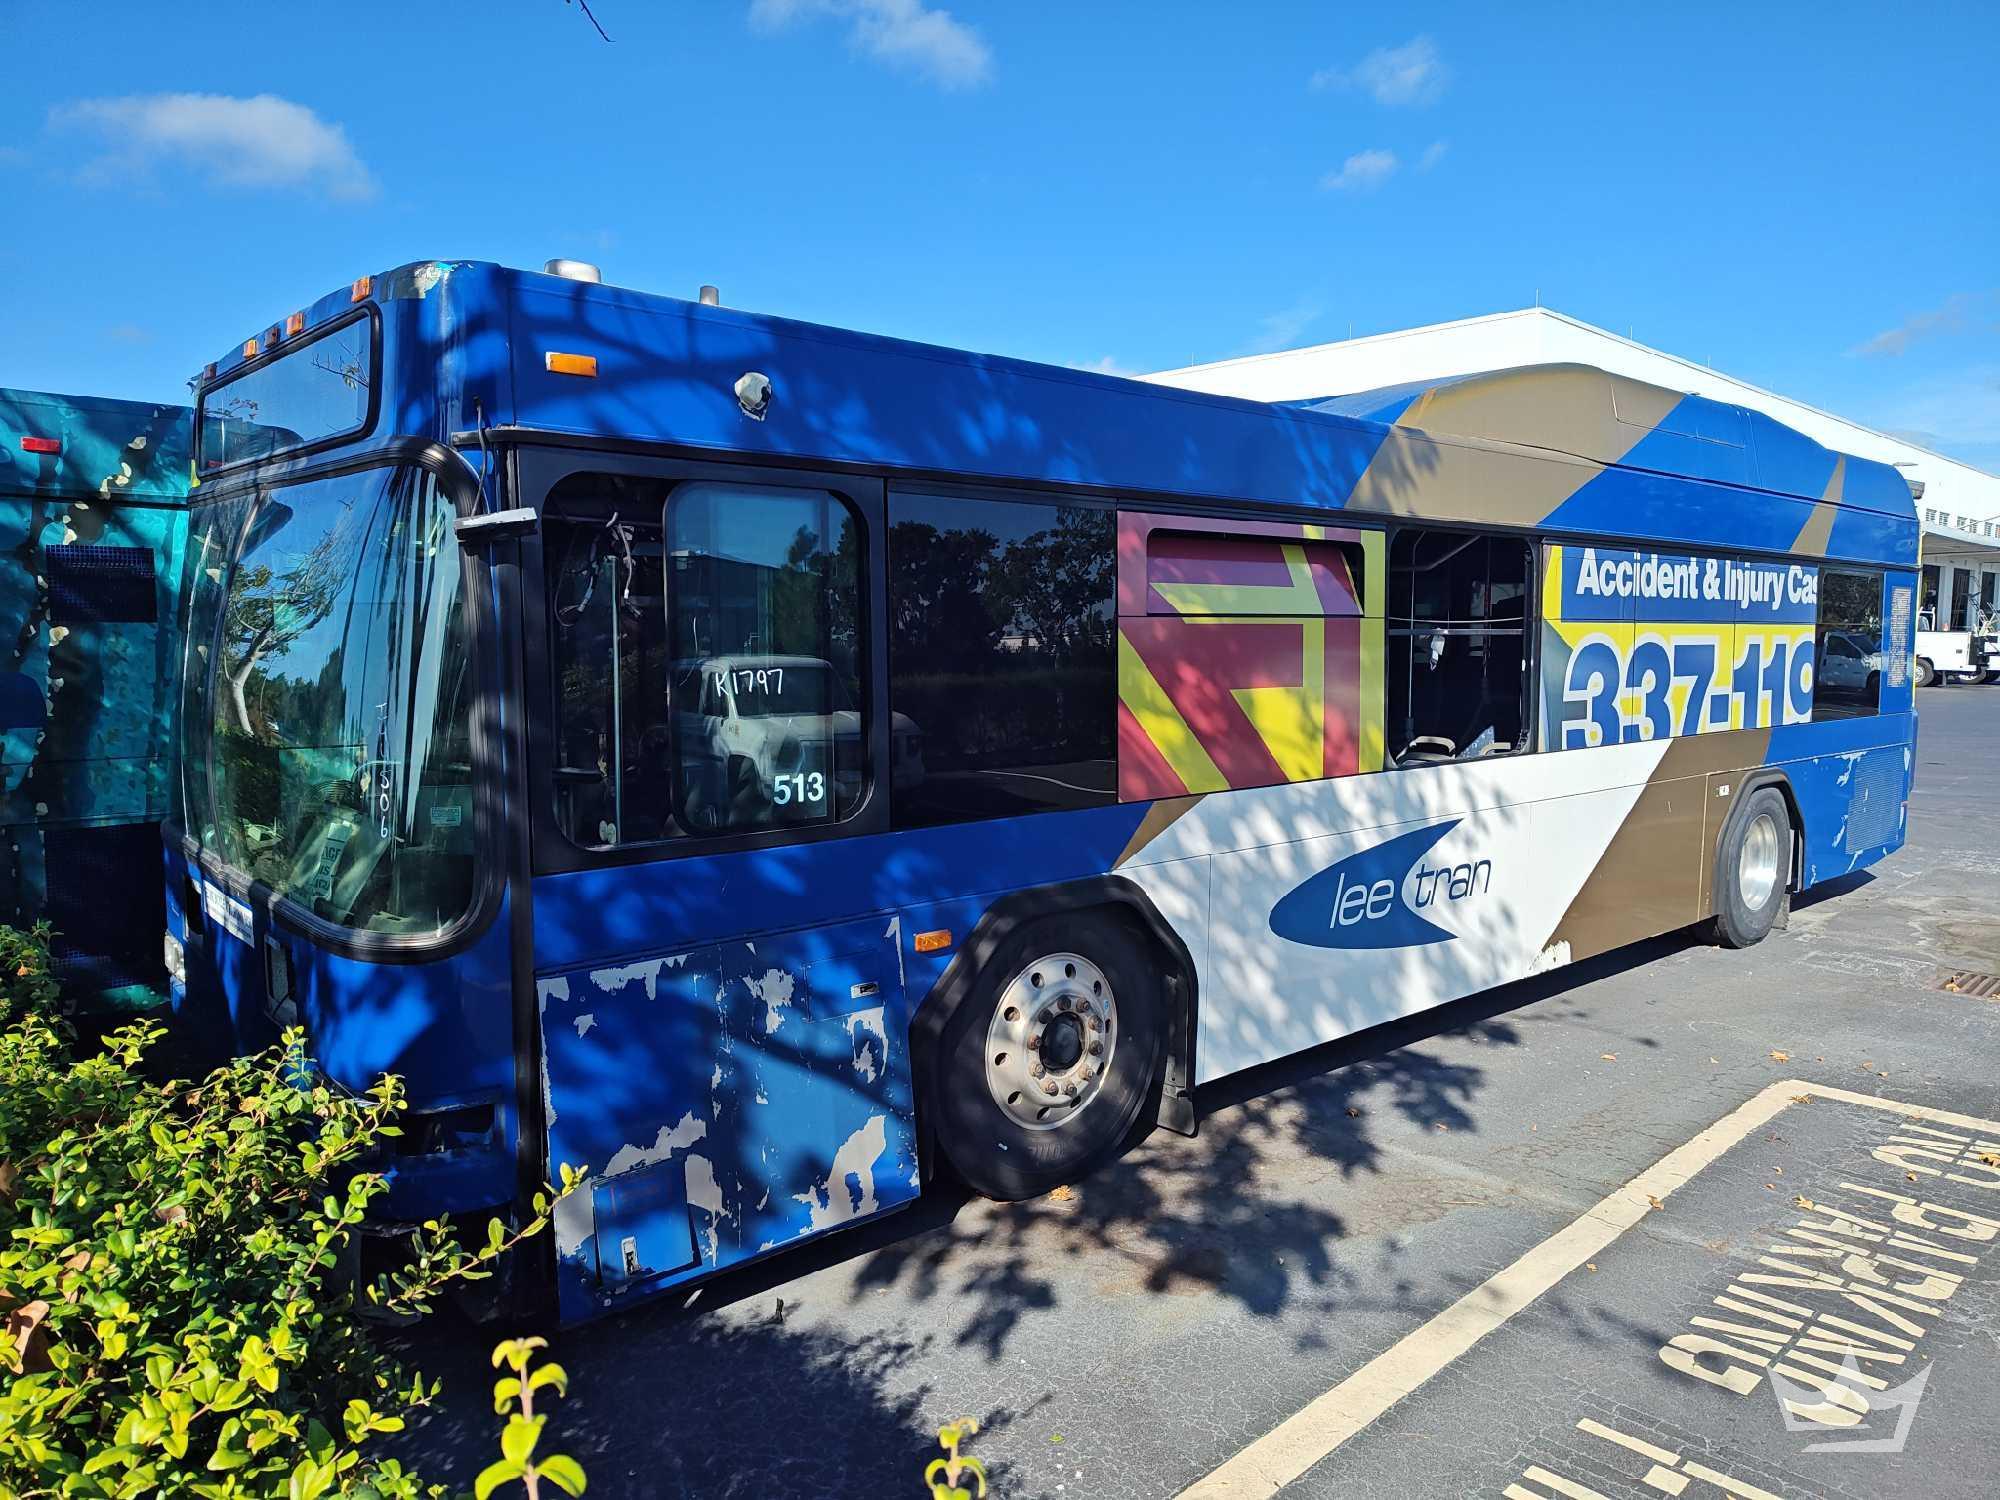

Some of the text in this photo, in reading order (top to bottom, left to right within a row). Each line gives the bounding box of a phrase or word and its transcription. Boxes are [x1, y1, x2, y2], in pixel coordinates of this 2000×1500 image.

[1576, 548, 1699, 598] Accident
[1702, 558, 1721, 600] &
[1725, 560, 1785, 610] Injury
[715, 668, 783, 697] K1797
[773, 772, 824, 805] 513
[1329, 859, 1491, 929] lee tran
[1658, 1181, 2000, 1427] PARKING
